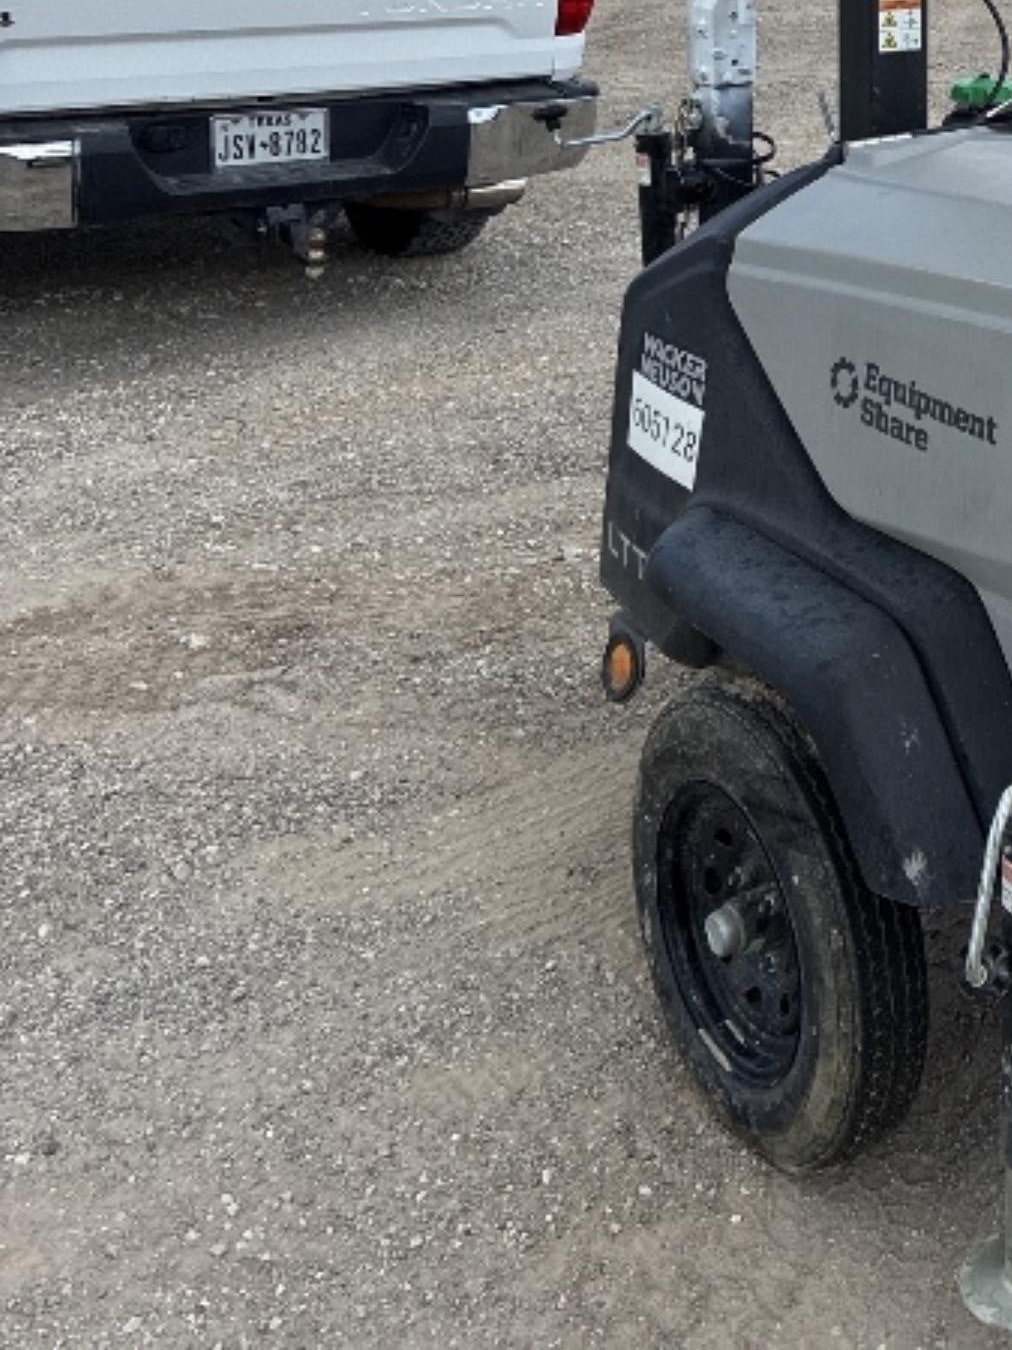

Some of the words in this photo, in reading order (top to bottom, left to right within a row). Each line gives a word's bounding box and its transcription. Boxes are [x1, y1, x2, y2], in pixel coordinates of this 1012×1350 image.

[641, 353, 706, 406] NEUSON
[643, 332, 707, 382] WACKER
[859, 396, 929, 451] Share
[863, 361, 998, 445] Equipment
